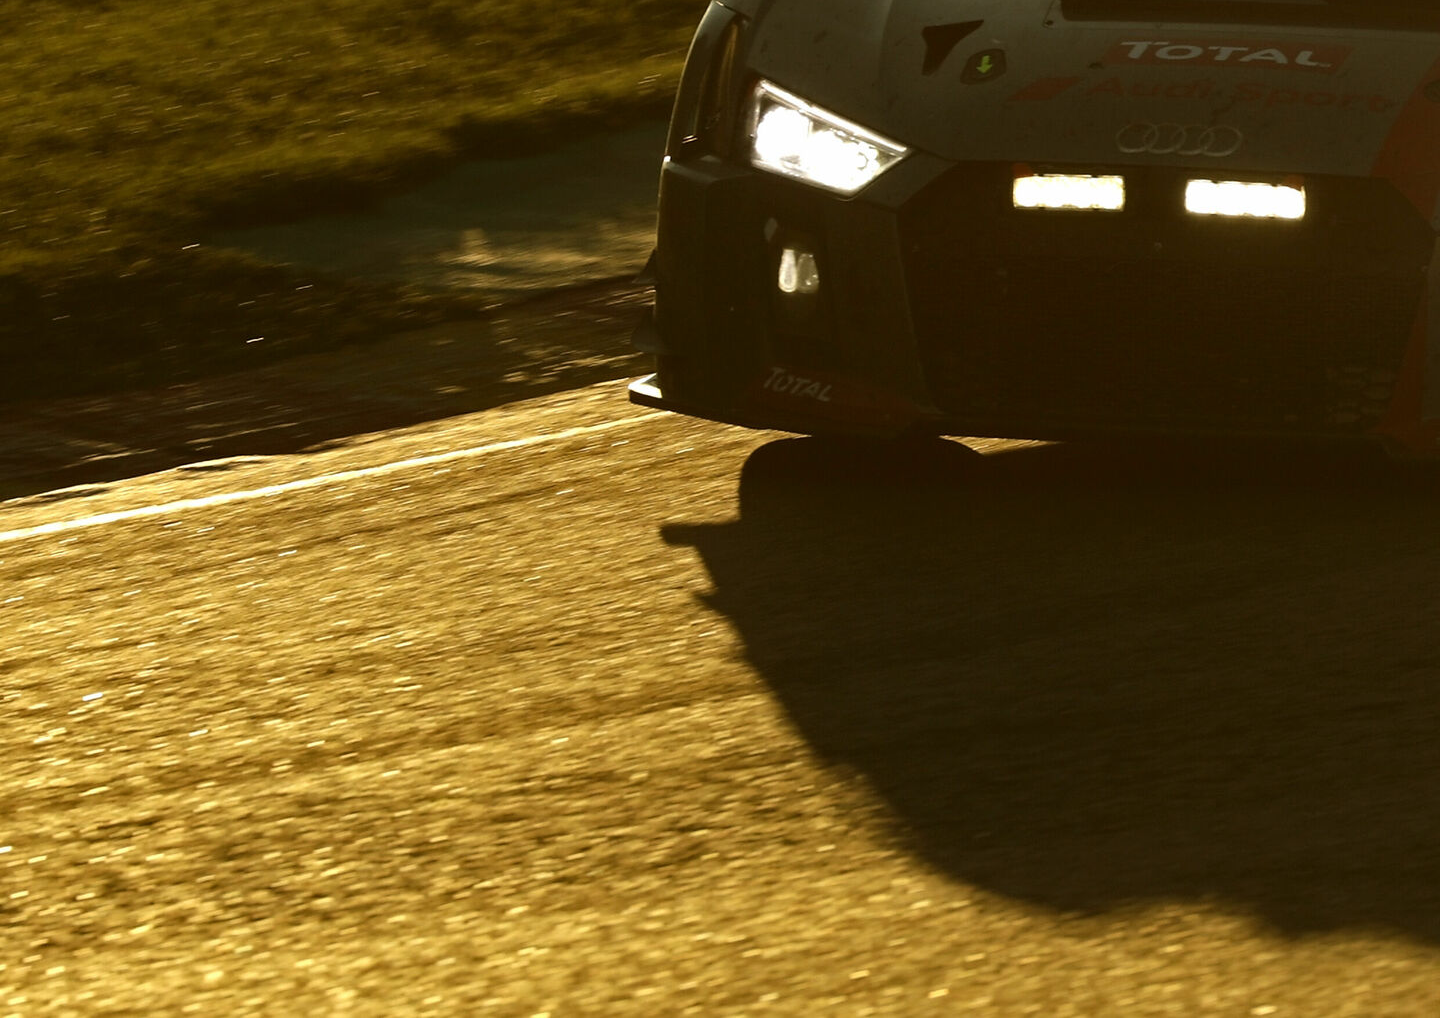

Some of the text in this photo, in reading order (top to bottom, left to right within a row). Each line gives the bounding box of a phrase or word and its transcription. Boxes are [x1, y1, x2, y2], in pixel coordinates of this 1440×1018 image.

[1120, 40, 1332, 68] TOTAL
[1083, 77, 1397, 114] Audi Sport
[764, 366, 833, 402] TOTAL
